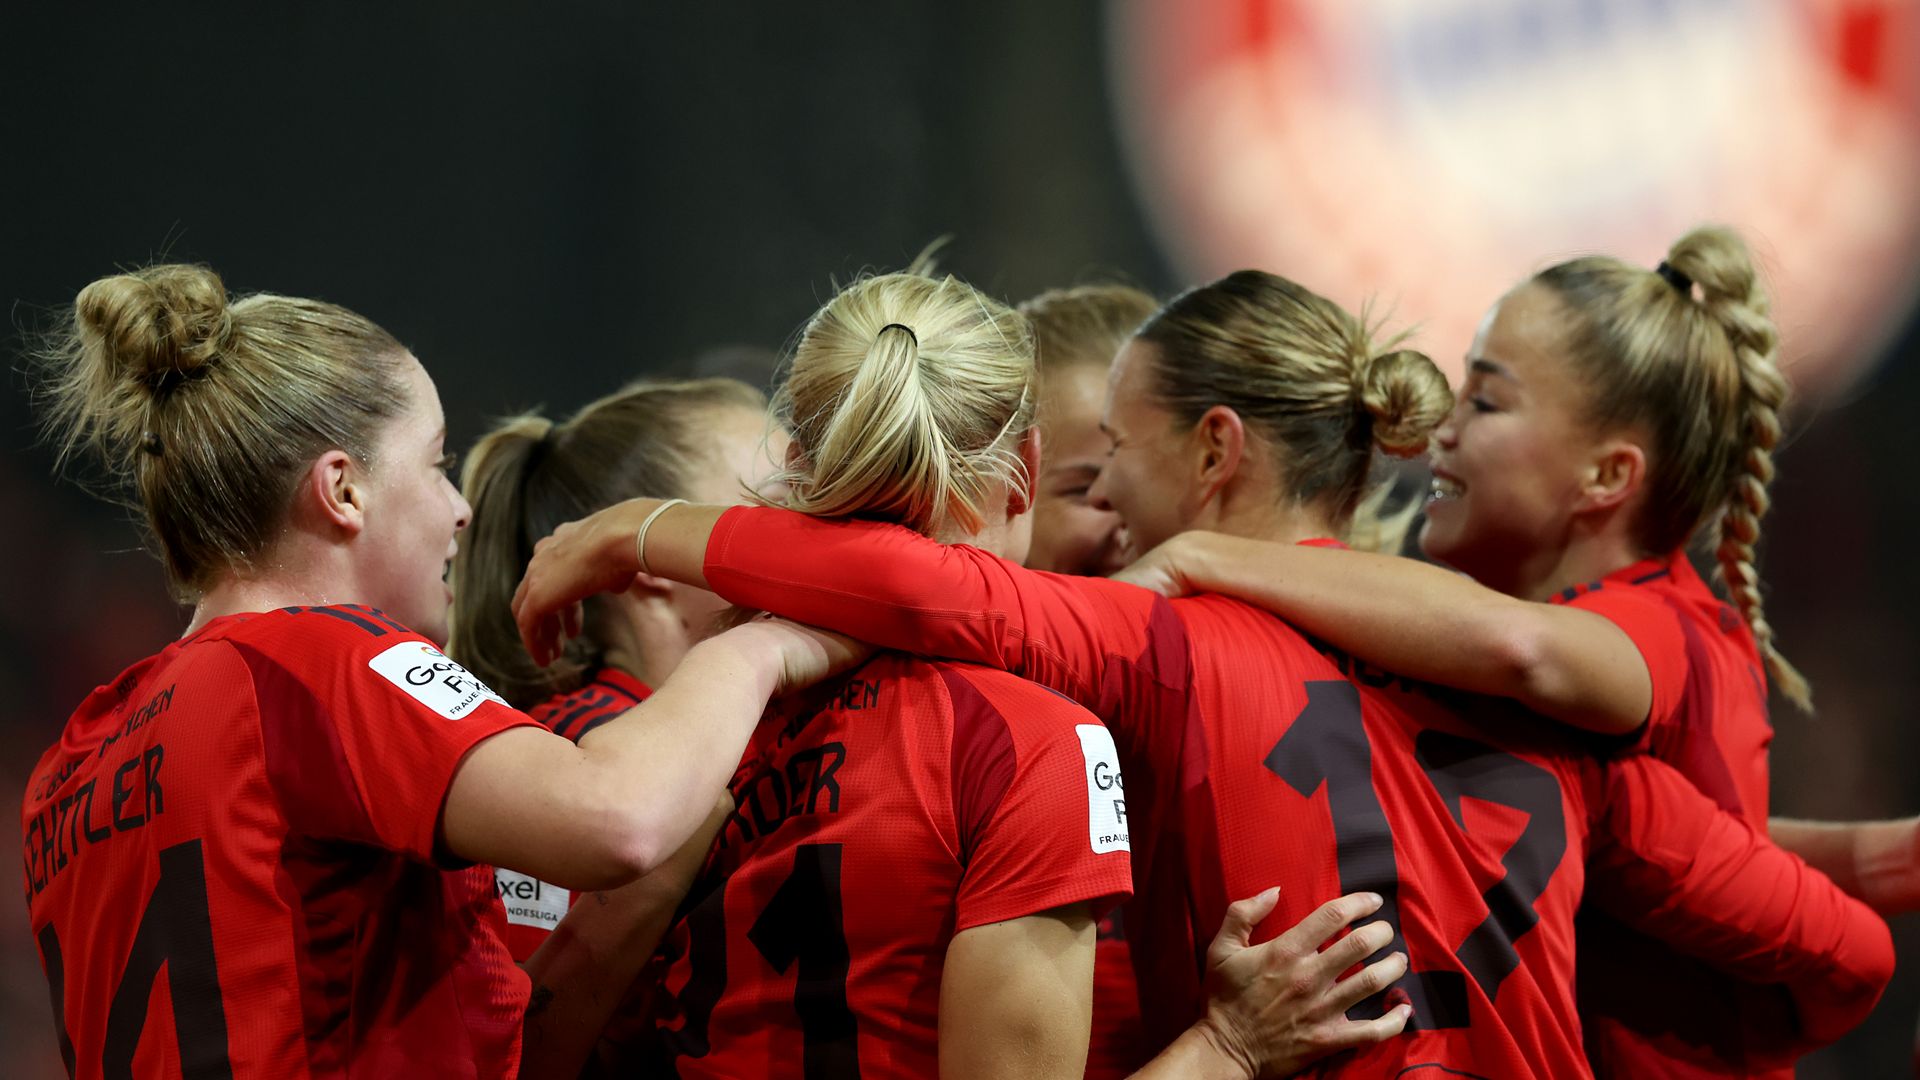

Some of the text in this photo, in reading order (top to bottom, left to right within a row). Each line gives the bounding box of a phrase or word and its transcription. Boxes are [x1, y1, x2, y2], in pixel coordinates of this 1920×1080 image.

[405, 662, 466, 686] Goo
[449, 691, 479, 716] FRAUE
[1098, 833, 1130, 845] FRAUE
[508, 907, 559, 922] NDESLIGA
